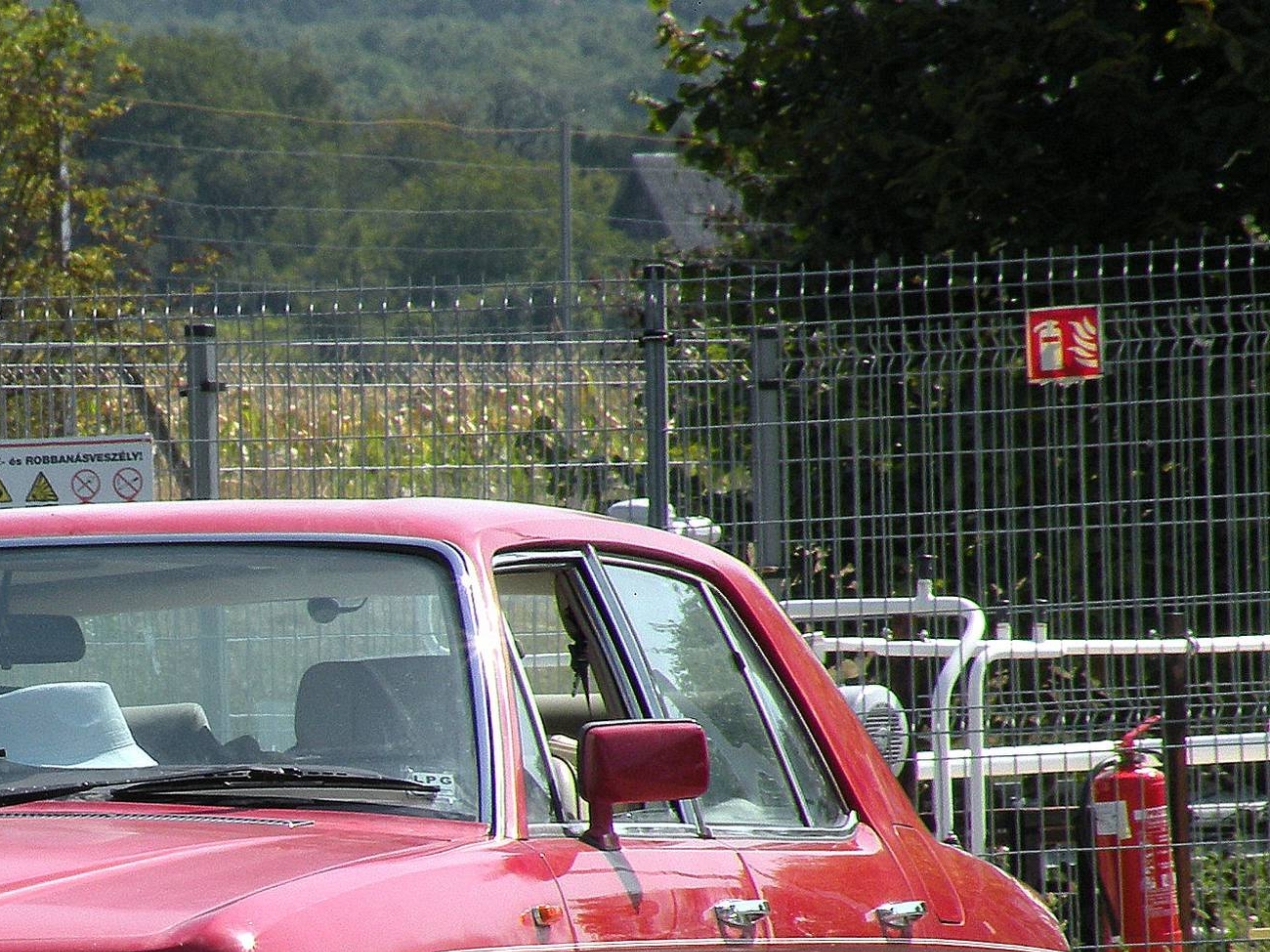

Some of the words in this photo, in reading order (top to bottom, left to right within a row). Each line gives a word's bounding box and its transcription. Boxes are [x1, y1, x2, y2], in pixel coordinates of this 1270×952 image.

[9, 458, 22, 466] és
[25, 451, 143, 465] ROBBANÁSVESZÉLY!
[414, 775, 452, 785] LPG
